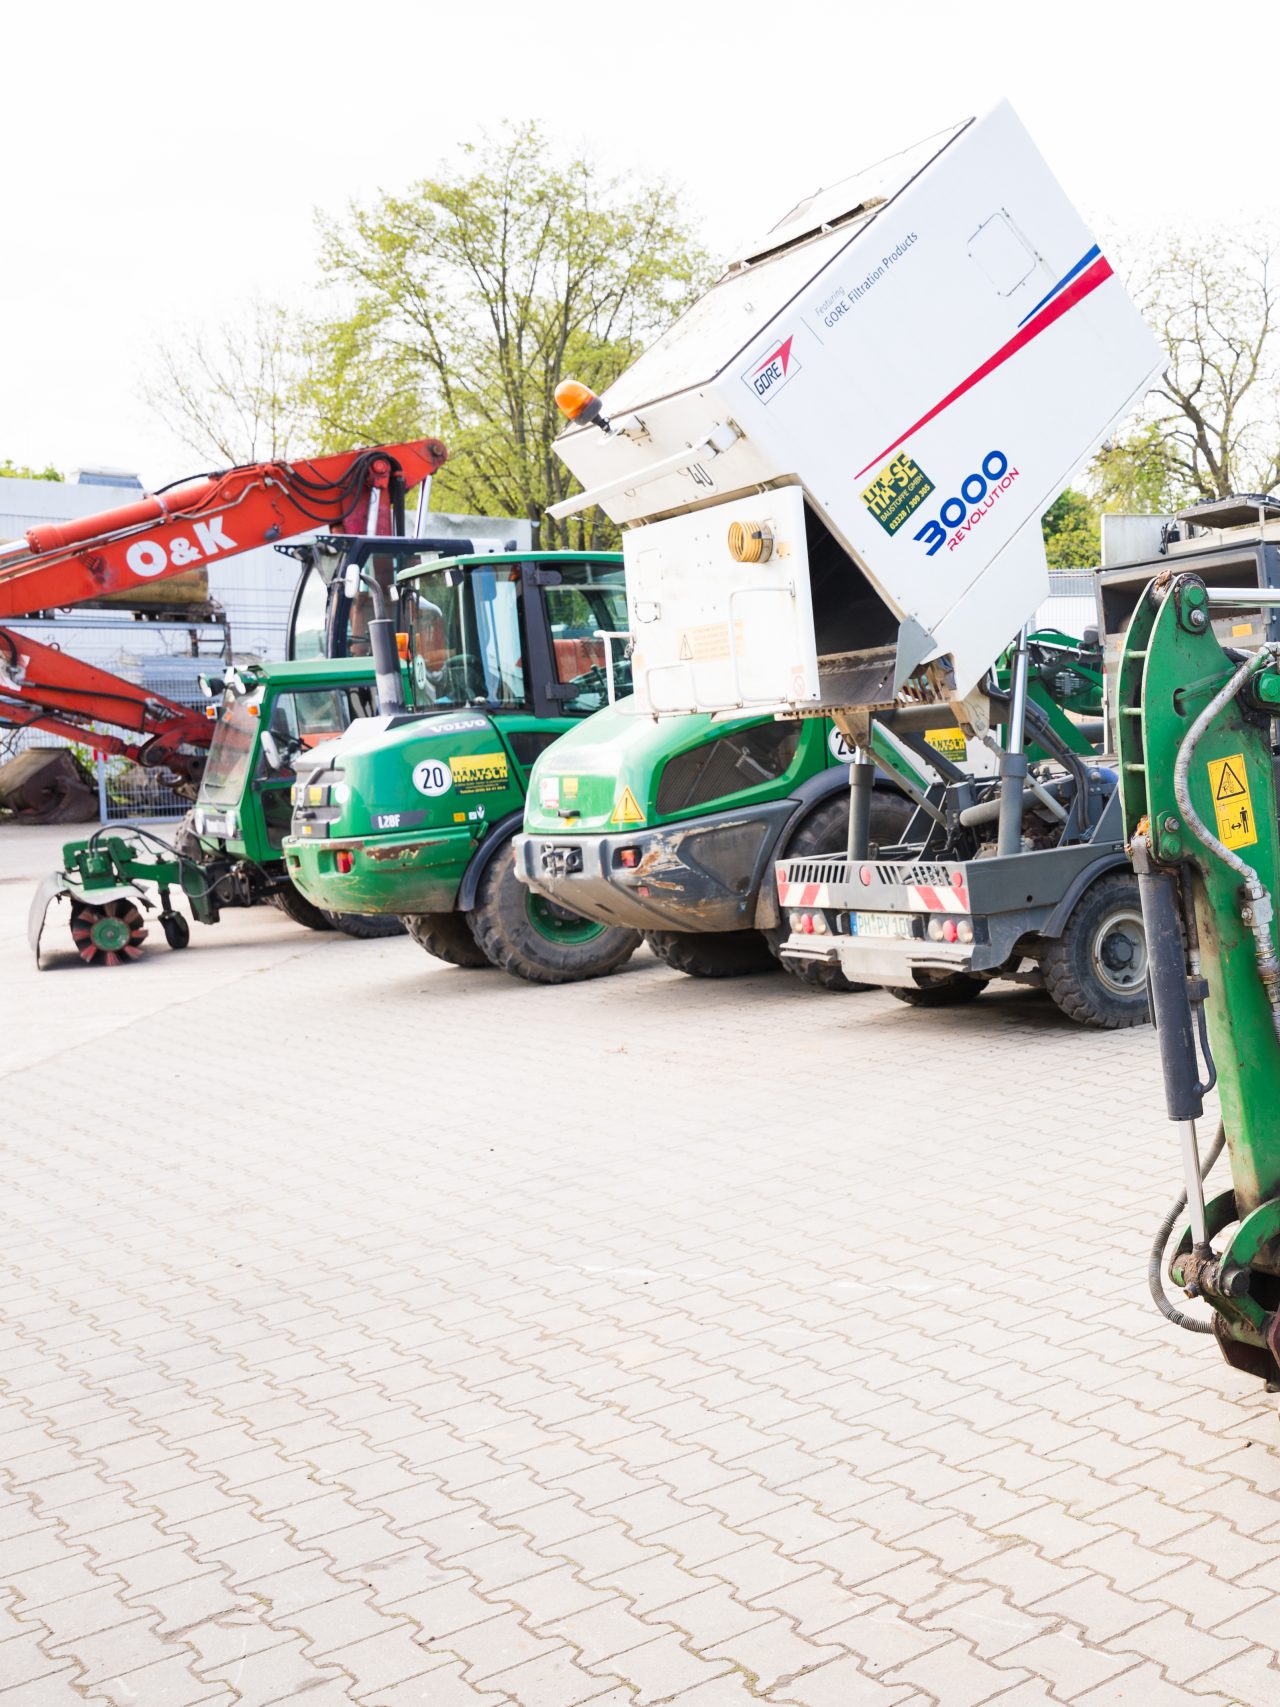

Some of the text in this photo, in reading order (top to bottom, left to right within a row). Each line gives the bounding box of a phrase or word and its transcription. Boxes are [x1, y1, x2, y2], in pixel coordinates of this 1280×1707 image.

[847, 266, 885, 304] Filtration
[882, 232, 918, 269] Products
[815, 286, 846, 317] Featuring
[753, 361, 782, 396] GORE
[880, 488, 909, 522] BAUSTOFFE
[889, 509, 907, 530] 03328
[912, 450, 1008, 557] 3000
[947, 467, 1020, 552] REVOLUTION
[126, 515, 239, 577] O&K
[430, 719, 487, 733] VOLVO
[928, 736, 965, 752] ÄNTSCH
[420, 766, 444, 790] 20
[453, 764, 508, 783] HÄNTSCH
